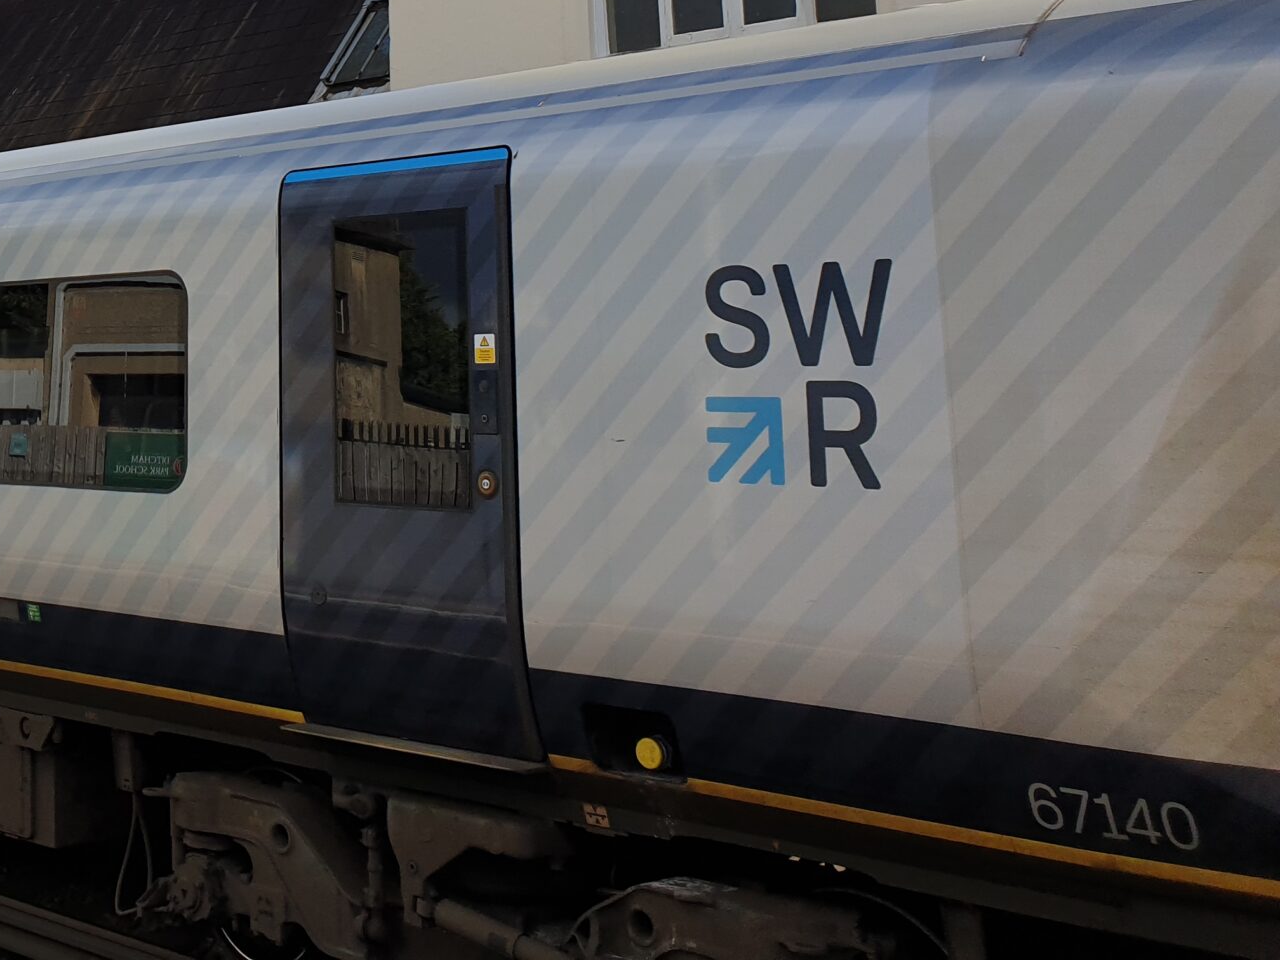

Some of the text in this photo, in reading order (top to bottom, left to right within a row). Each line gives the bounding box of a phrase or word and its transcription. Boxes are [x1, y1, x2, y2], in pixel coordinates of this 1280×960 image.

[705, 259, 892, 368] SW
[806, 380, 881, 489] R
[1028, 782, 1200, 851] 67140
